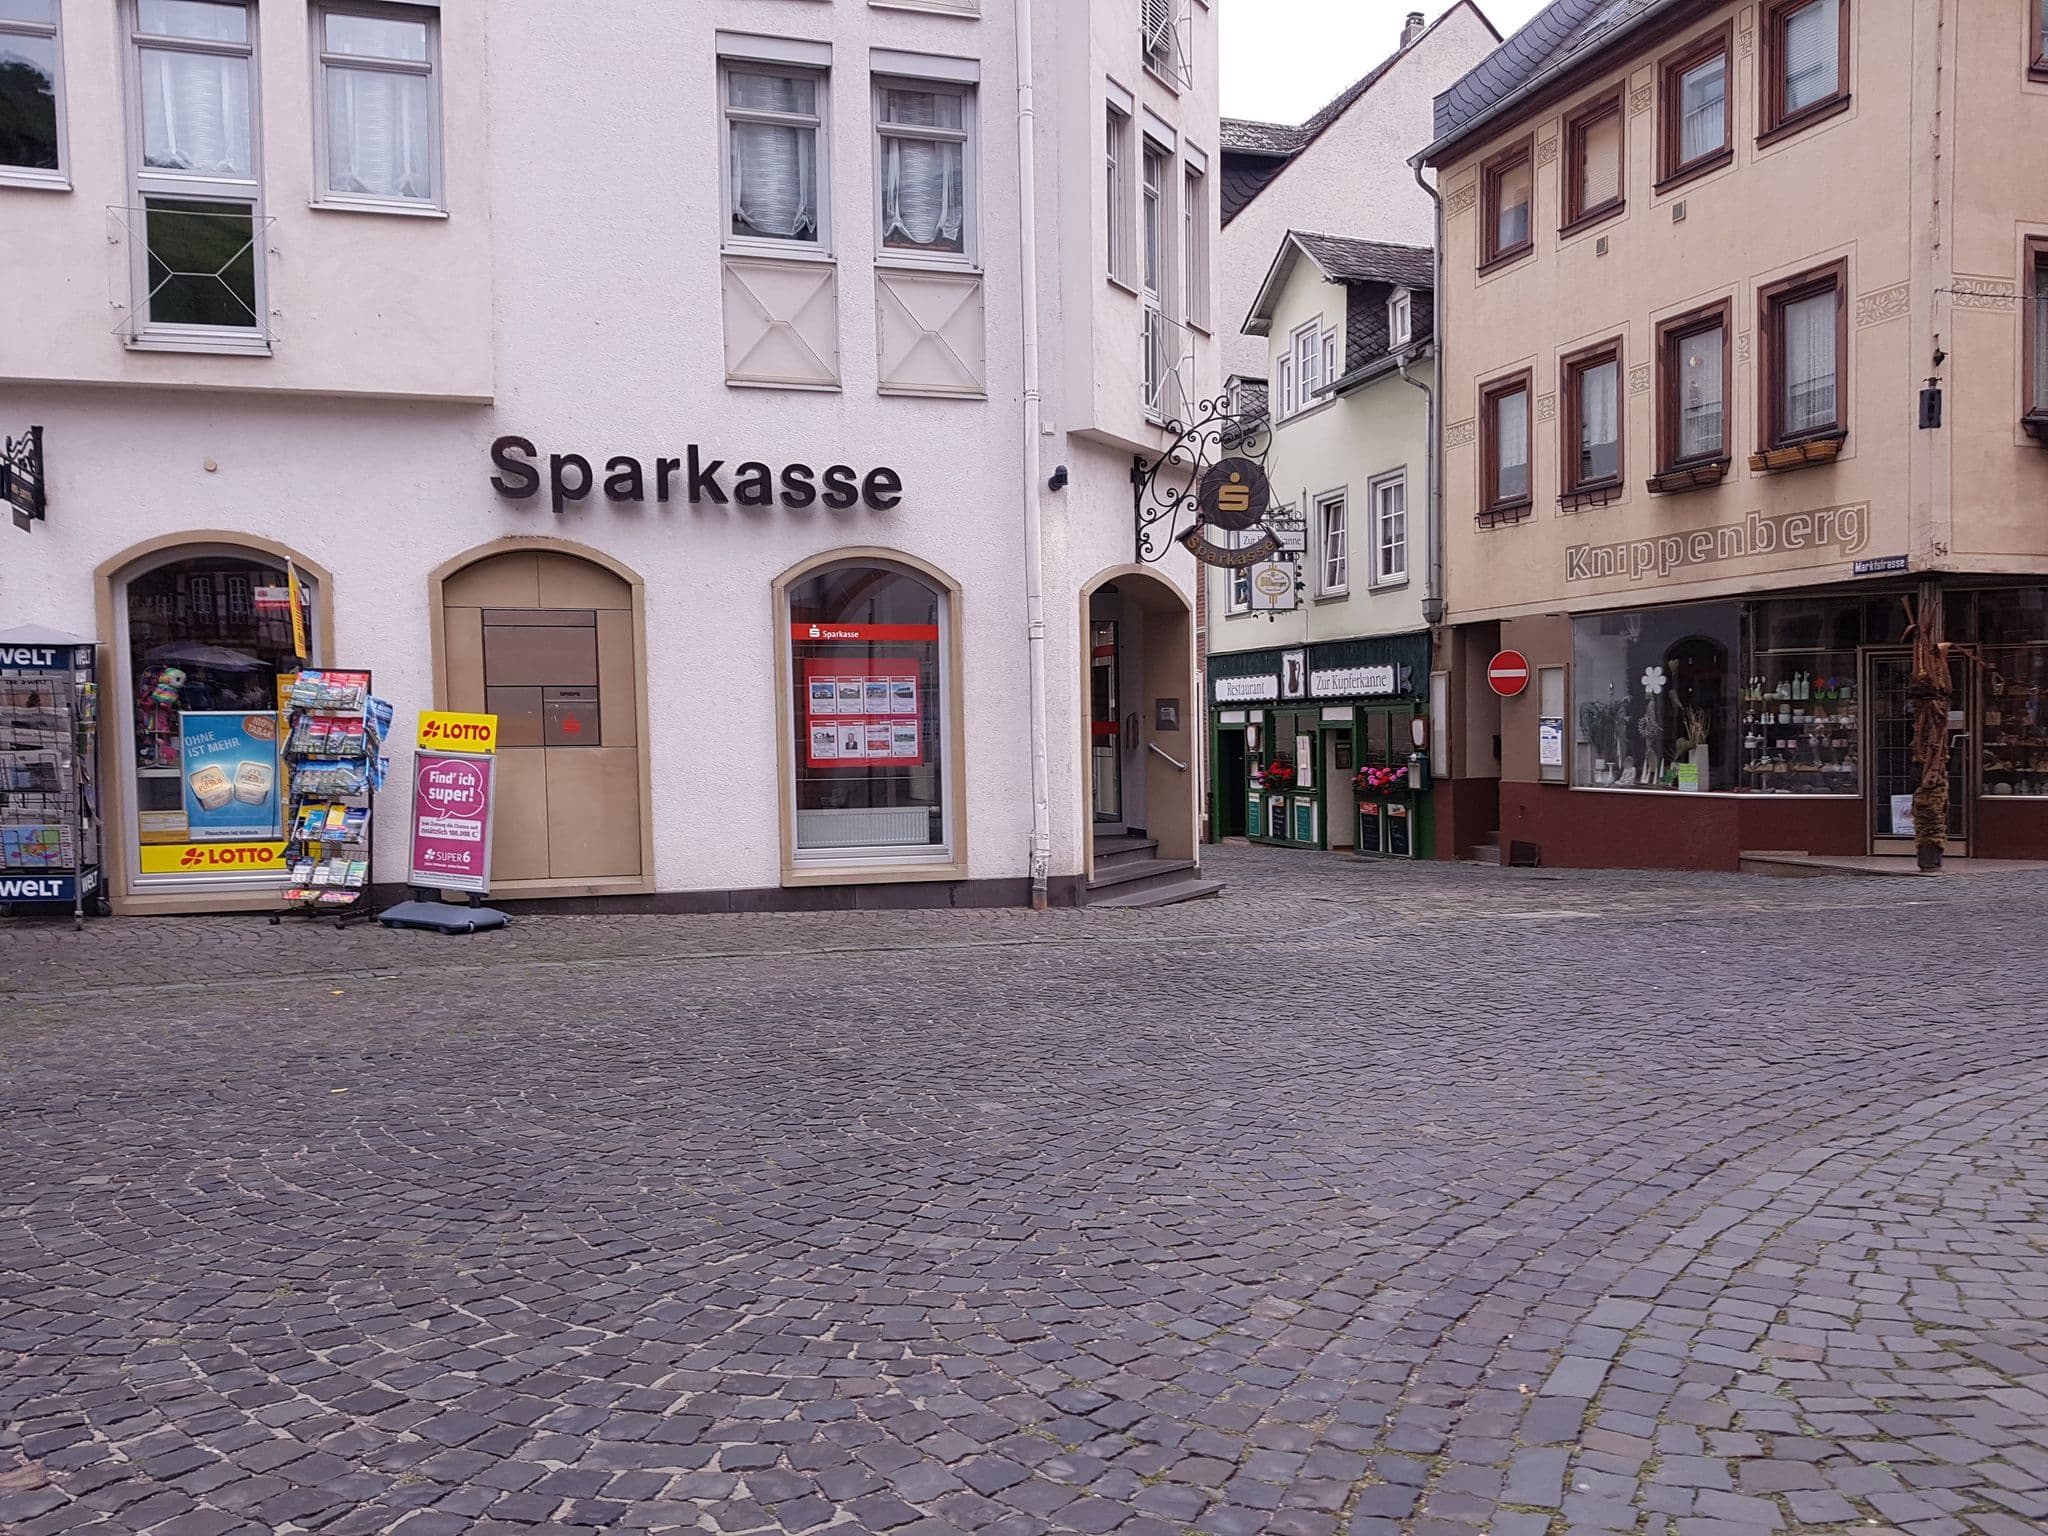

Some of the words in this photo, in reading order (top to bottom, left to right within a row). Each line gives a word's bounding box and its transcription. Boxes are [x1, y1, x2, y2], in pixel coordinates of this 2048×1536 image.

[490, 435, 903, 514] Sparkasse
[1187, 536, 1275, 565] Sparkasse
[1567, 504, 1870, 581] Knippenberg
[1854, 559, 1905, 573] Marktstrasse
[822, 630, 859, 639] Sparkasse
[1226, 682, 1265, 697] Restaurant
[1316, 675, 1330, 691] Zur
[1332, 673, 1387, 693] Kupferkanne
[185, 730, 216, 746] OHNE
[443, 723, 491, 741] LOTTO
[188, 745, 205, 758] IST
[208, 737, 240, 753] MEHR
[458, 772, 475, 786] ich
[428, 787, 475, 804] super!
[209, 847, 274, 864] LOTTO
